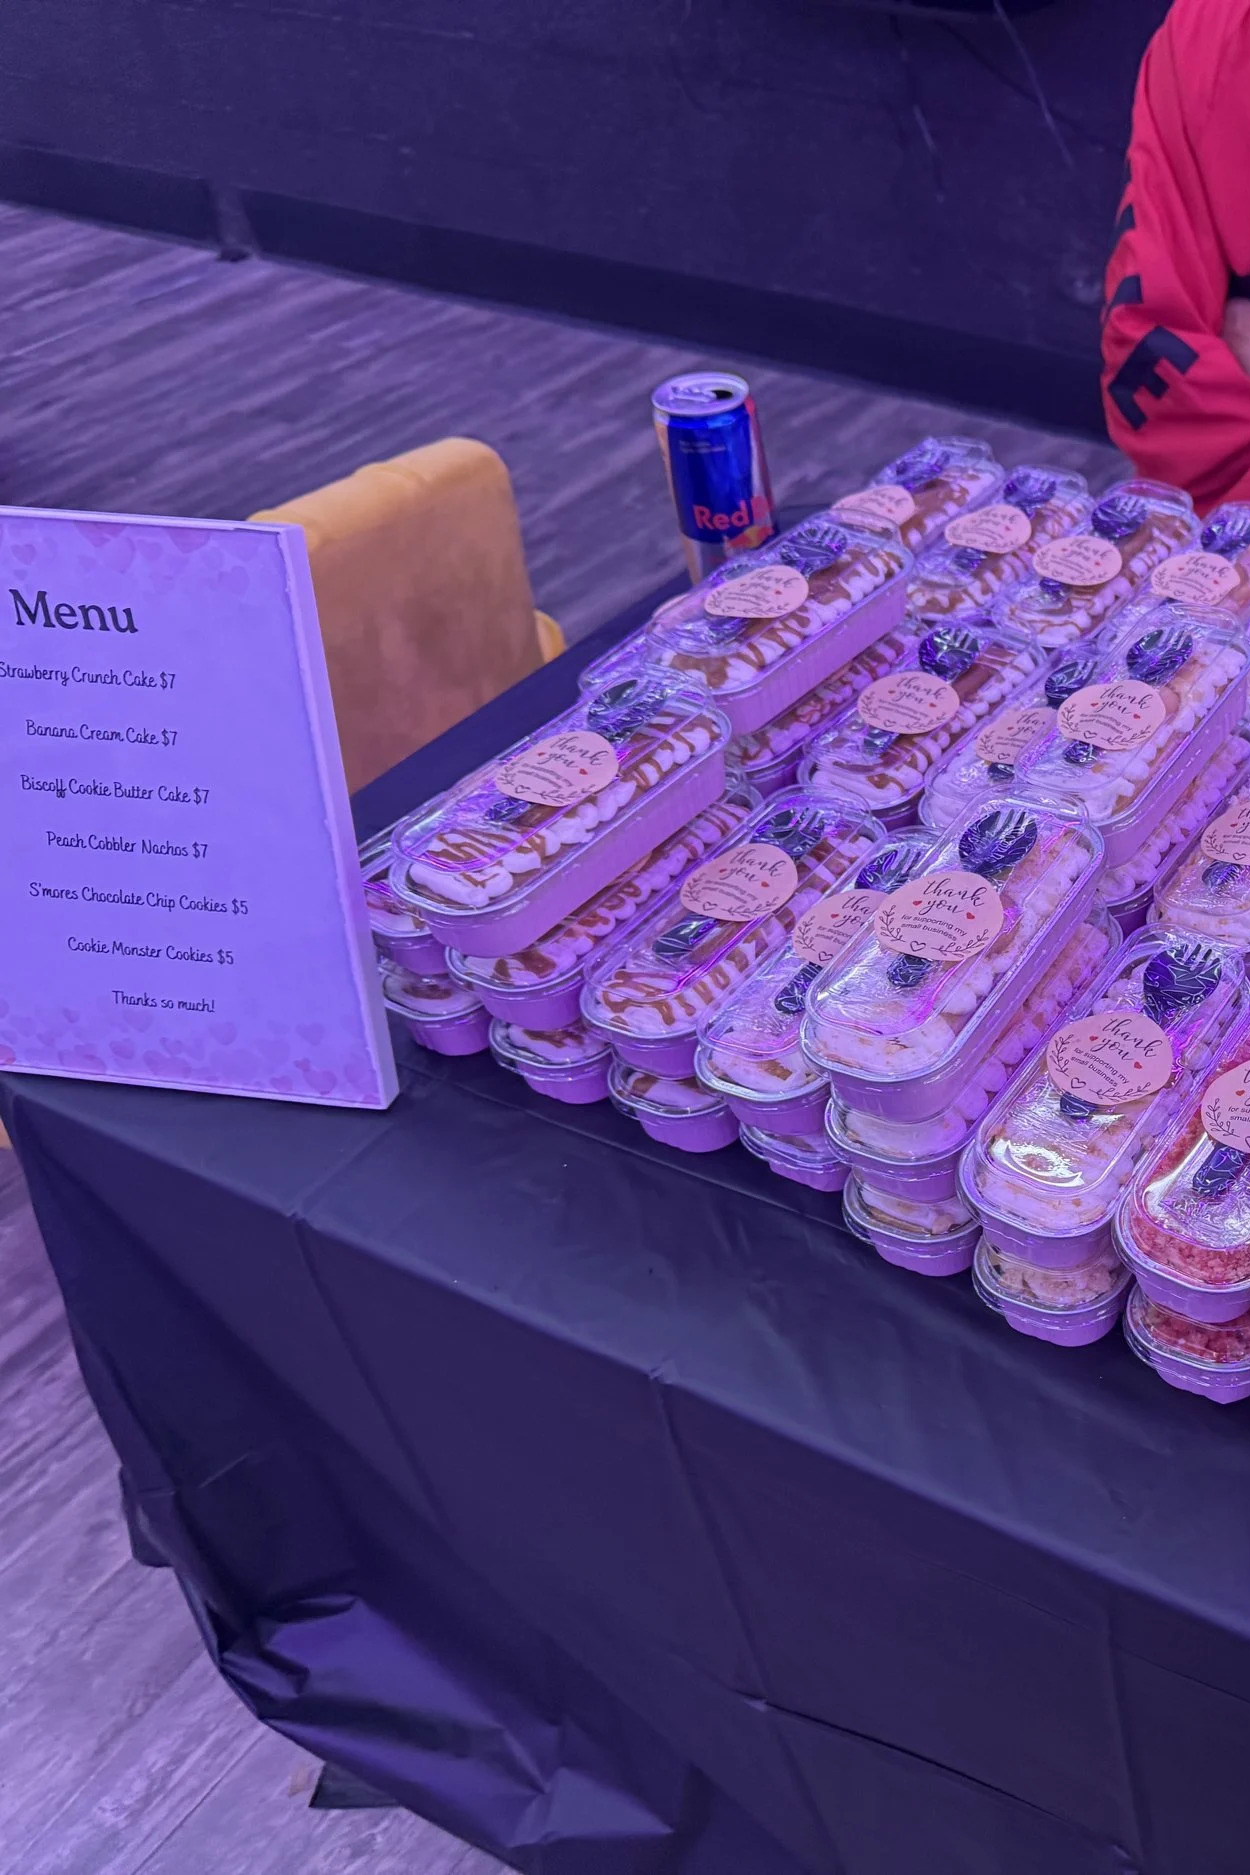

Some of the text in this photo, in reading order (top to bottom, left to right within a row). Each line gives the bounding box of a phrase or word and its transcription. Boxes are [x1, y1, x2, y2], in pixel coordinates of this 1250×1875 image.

[692, 499, 750, 530] Red
[8, 588, 139, 634] Menu
[71, 666, 122, 686] Crunch
[122, 670, 158, 688] Cake
[160, 671, 176, 690] $7
[1094, 701, 1132, 714] you
[1100, 685, 1154, 709] thank
[26, 719, 178, 746] Banana Cream Cake $7
[20, 774, 210, 805] Biscoff Cookie Butter Cake $7
[46, 831, 208, 859] Peach Cobbler Nachos $7
[720, 868, 760, 882] you
[730, 849, 786, 877] thank
[29, 882, 249, 915] S'mores Chocolate Chip Cookies $5
[923, 878, 987, 906] thank
[919, 900, 964, 915] you
[913, 916, 954, 929] supporting
[955, 928, 967, 936] my
[922, 925, 957, 941] business
[67, 936, 234, 965] Cookie Monster Cookies $5
[111, 990, 215, 1013] Thanks so much!
[1090, 1038, 1134, 1060] you
[1102, 1019, 1162, 1057] thank
[1071, 1056, 1118, 1087] small business
[1084, 1052, 1120, 1076] supporting
[1118, 1073, 1130, 1084] my
